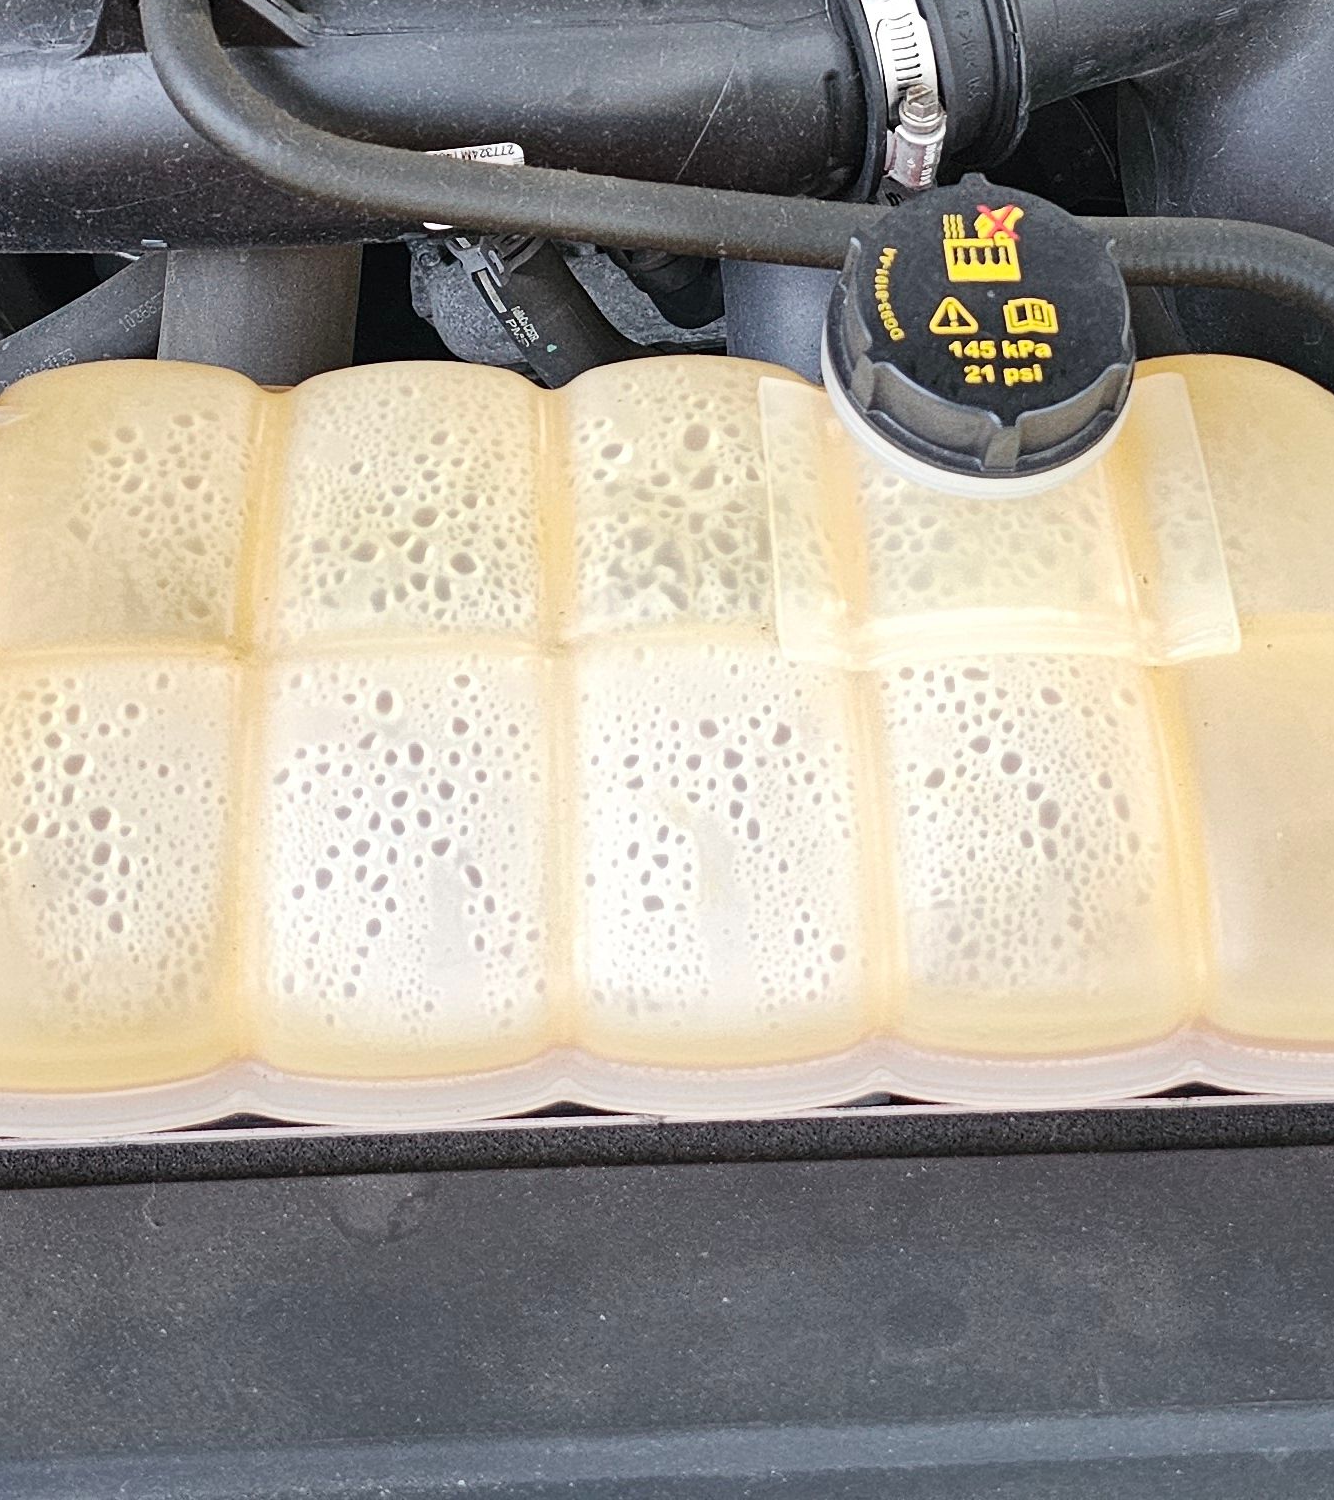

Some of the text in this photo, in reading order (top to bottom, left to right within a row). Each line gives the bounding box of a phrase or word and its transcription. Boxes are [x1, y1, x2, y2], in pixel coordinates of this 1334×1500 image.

[948, 338, 1053, 360] 145 kPa
[963, 363, 1043, 387] 21 psi
